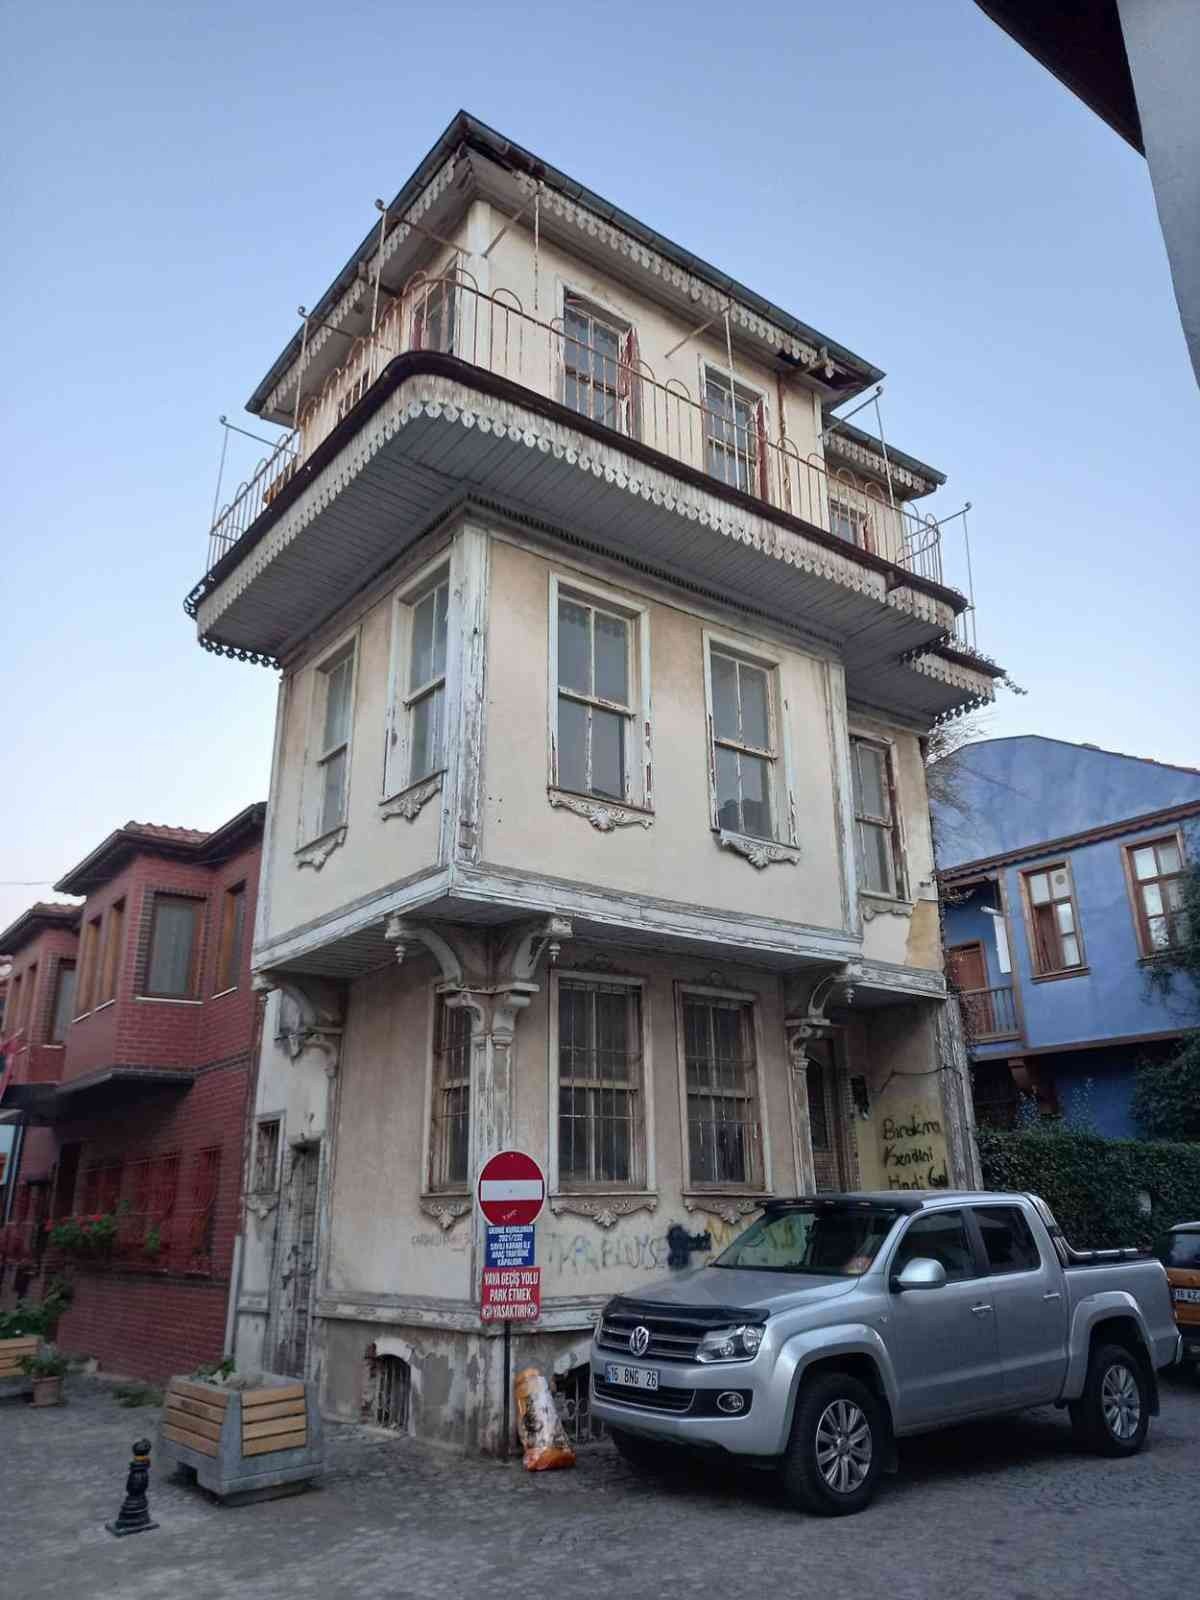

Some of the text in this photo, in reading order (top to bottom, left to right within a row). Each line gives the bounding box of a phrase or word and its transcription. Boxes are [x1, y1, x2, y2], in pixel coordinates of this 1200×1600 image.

[485, 1270, 538, 1287] YAYA GEÇİŞ YOLU
[490, 1288, 531, 1301] PARK ETMEK
[624, 1368, 639, 1385] BNG
[646, 1372, 657, 1388] 26
